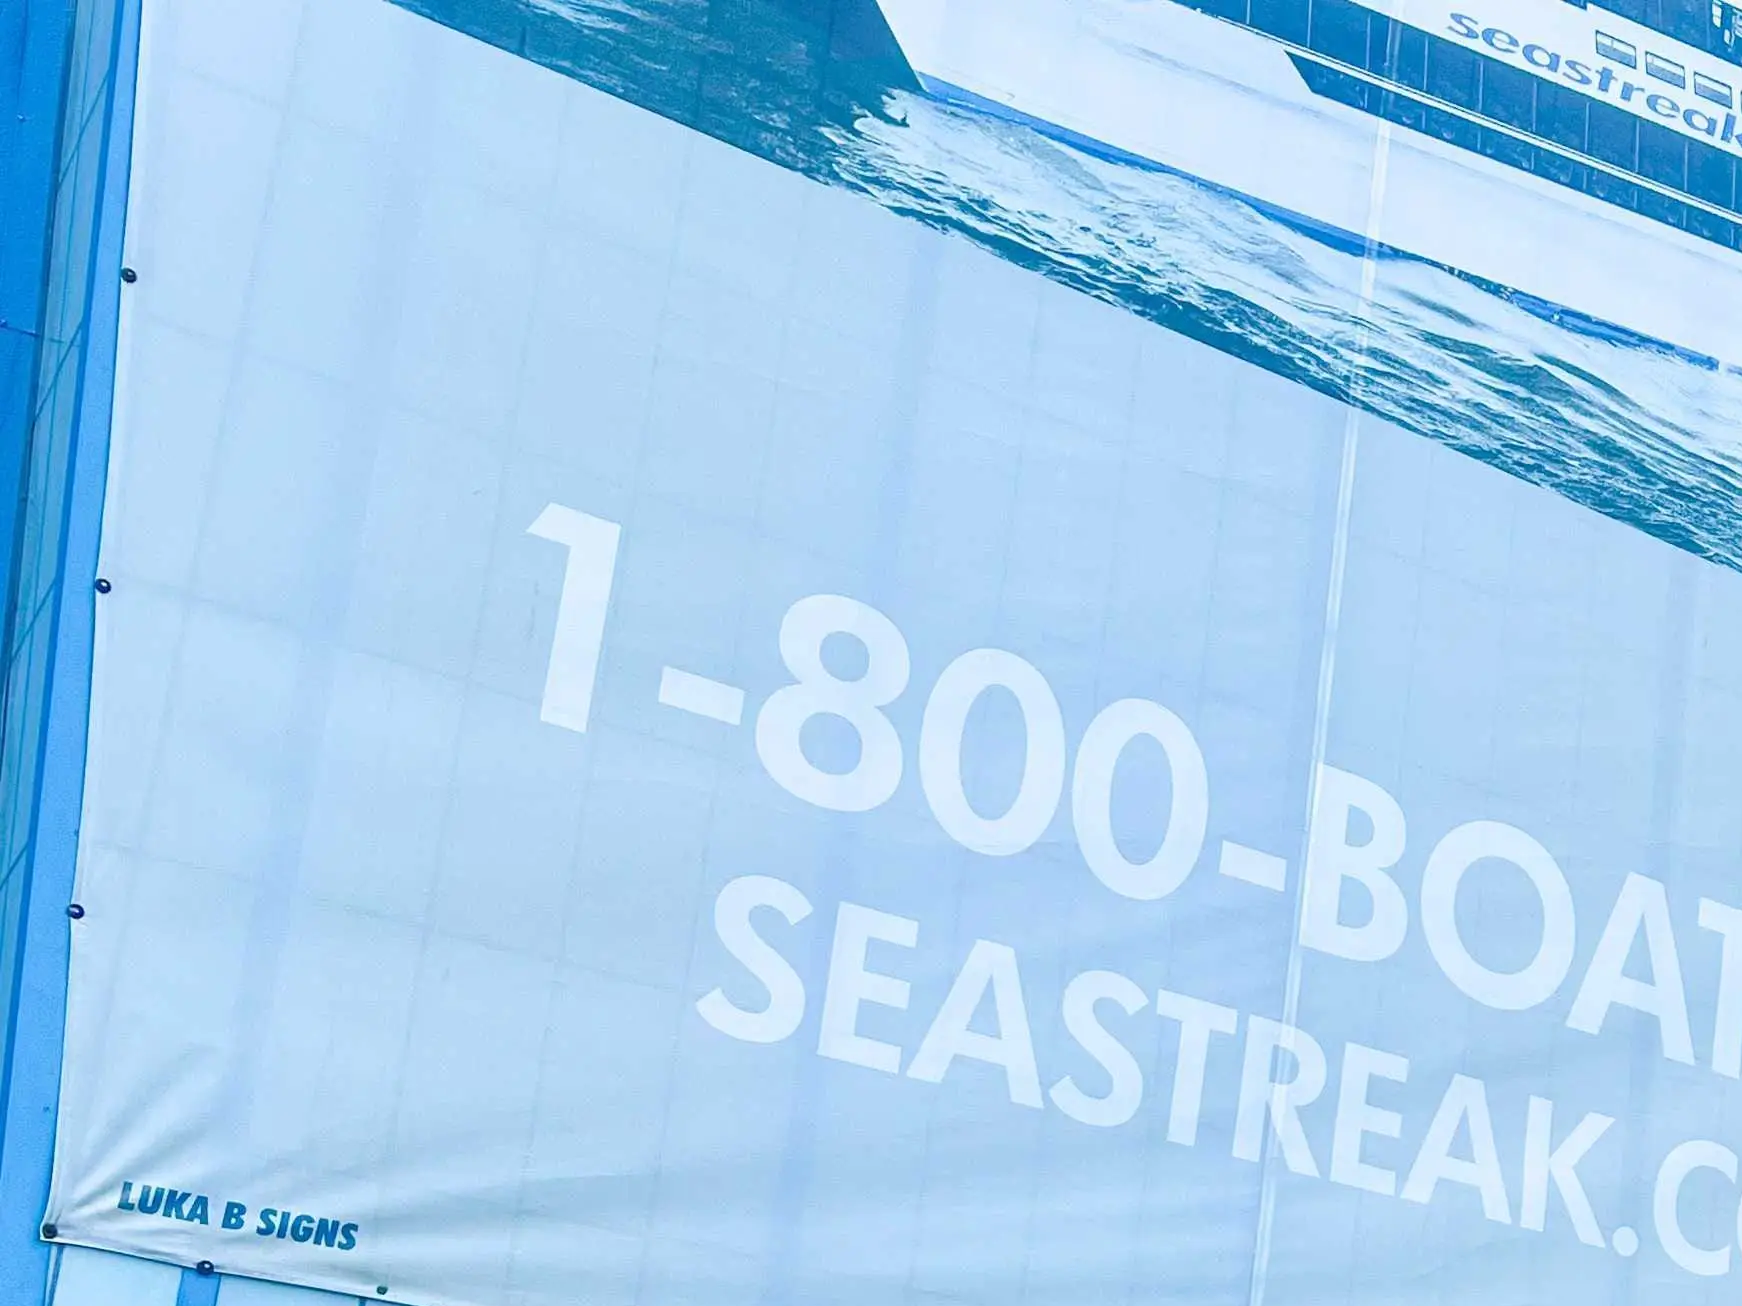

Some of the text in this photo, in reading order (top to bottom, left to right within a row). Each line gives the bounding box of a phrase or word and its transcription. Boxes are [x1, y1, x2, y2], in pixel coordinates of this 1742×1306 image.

[117, 1181, 359, 1250] LUKA B SIGNS
